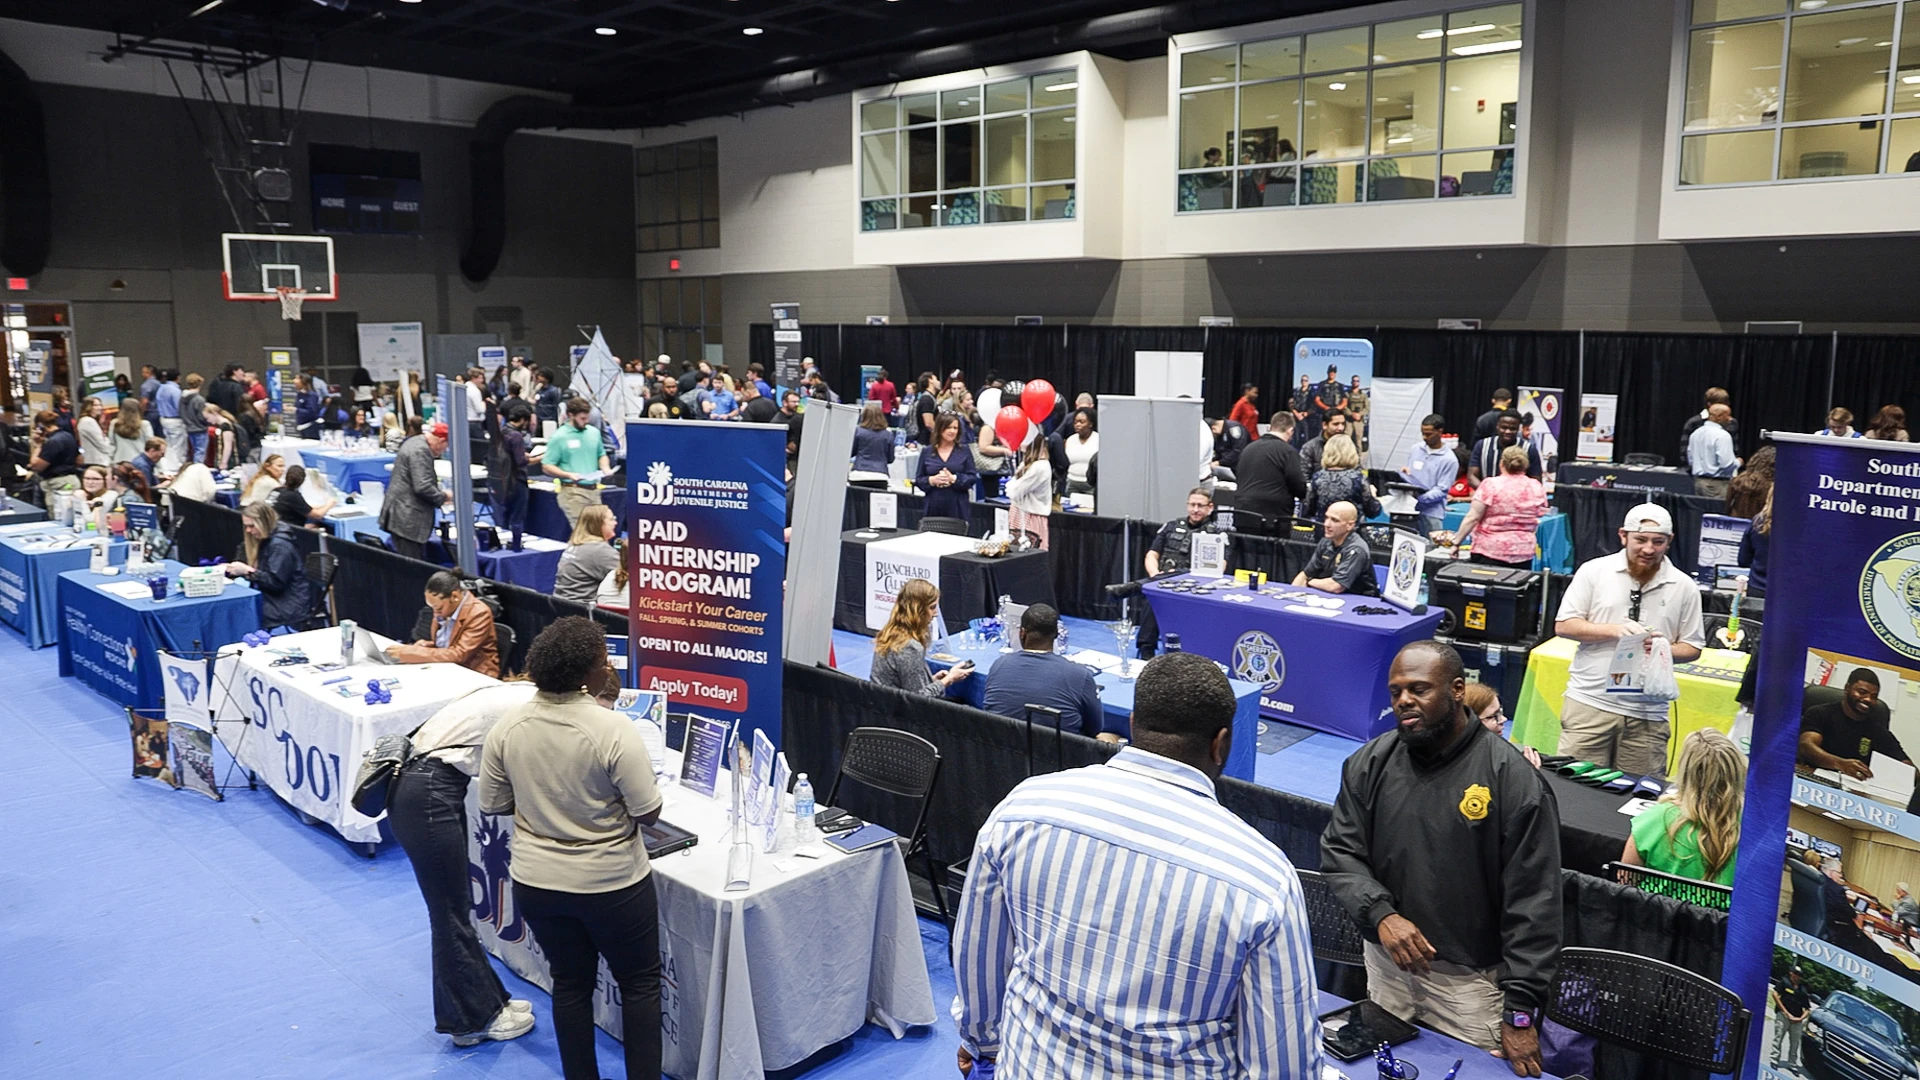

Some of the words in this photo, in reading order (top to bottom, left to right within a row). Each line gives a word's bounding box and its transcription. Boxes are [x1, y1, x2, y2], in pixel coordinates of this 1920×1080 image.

[320, 197, 345, 208] HOME
[392, 200, 418, 212] GUEST
[1311, 348, 1341, 357] MBPD
[637, 482, 674, 505] DJJ
[673, 478, 703, 489] SOUTH
[704, 480, 748, 491] CAROLINA
[674, 488, 732, 498] DEPARTMENT
[736, 492, 748, 500] OF
[1818, 473, 1920, 500] Departmen
[673, 497, 713, 508] JUVENILE
[713, 499, 748, 510] JUSTICE
[1808, 493, 1867, 515] Parole
[1870, 504, 1908, 520] and
[638, 518, 688, 542] PAID
[1703, 519, 1733, 531] STEM
[639, 543, 760, 575] INTERNSHIP
[875, 561, 931, 581] BLANCHARD
[639, 568, 751, 600] PROGRAM!
[639, 596, 692, 613] Kickstart
[695, 602, 723, 617] Your
[725, 605, 768, 622] Career
[639, 613, 658, 623] FALL,
[658, 615, 689, 627] SPRING,
[689, 618, 696, 627] &
[697, 619, 727, 632] SUMMER
[727, 623, 764, 636] COHORTS
[639, 636, 671, 652] OPEN
[673, 640, 690, 653] TO
[691, 643, 714, 657] ALL
[714, 645, 768, 665] MAJORS!
[649, 676, 690, 697] Apply
[692, 681, 738, 703] Today!
[250, 676, 290, 742] SC
[1795, 783, 1899, 829] PREPARE
[1779, 927, 1875, 983] PROVIDE
